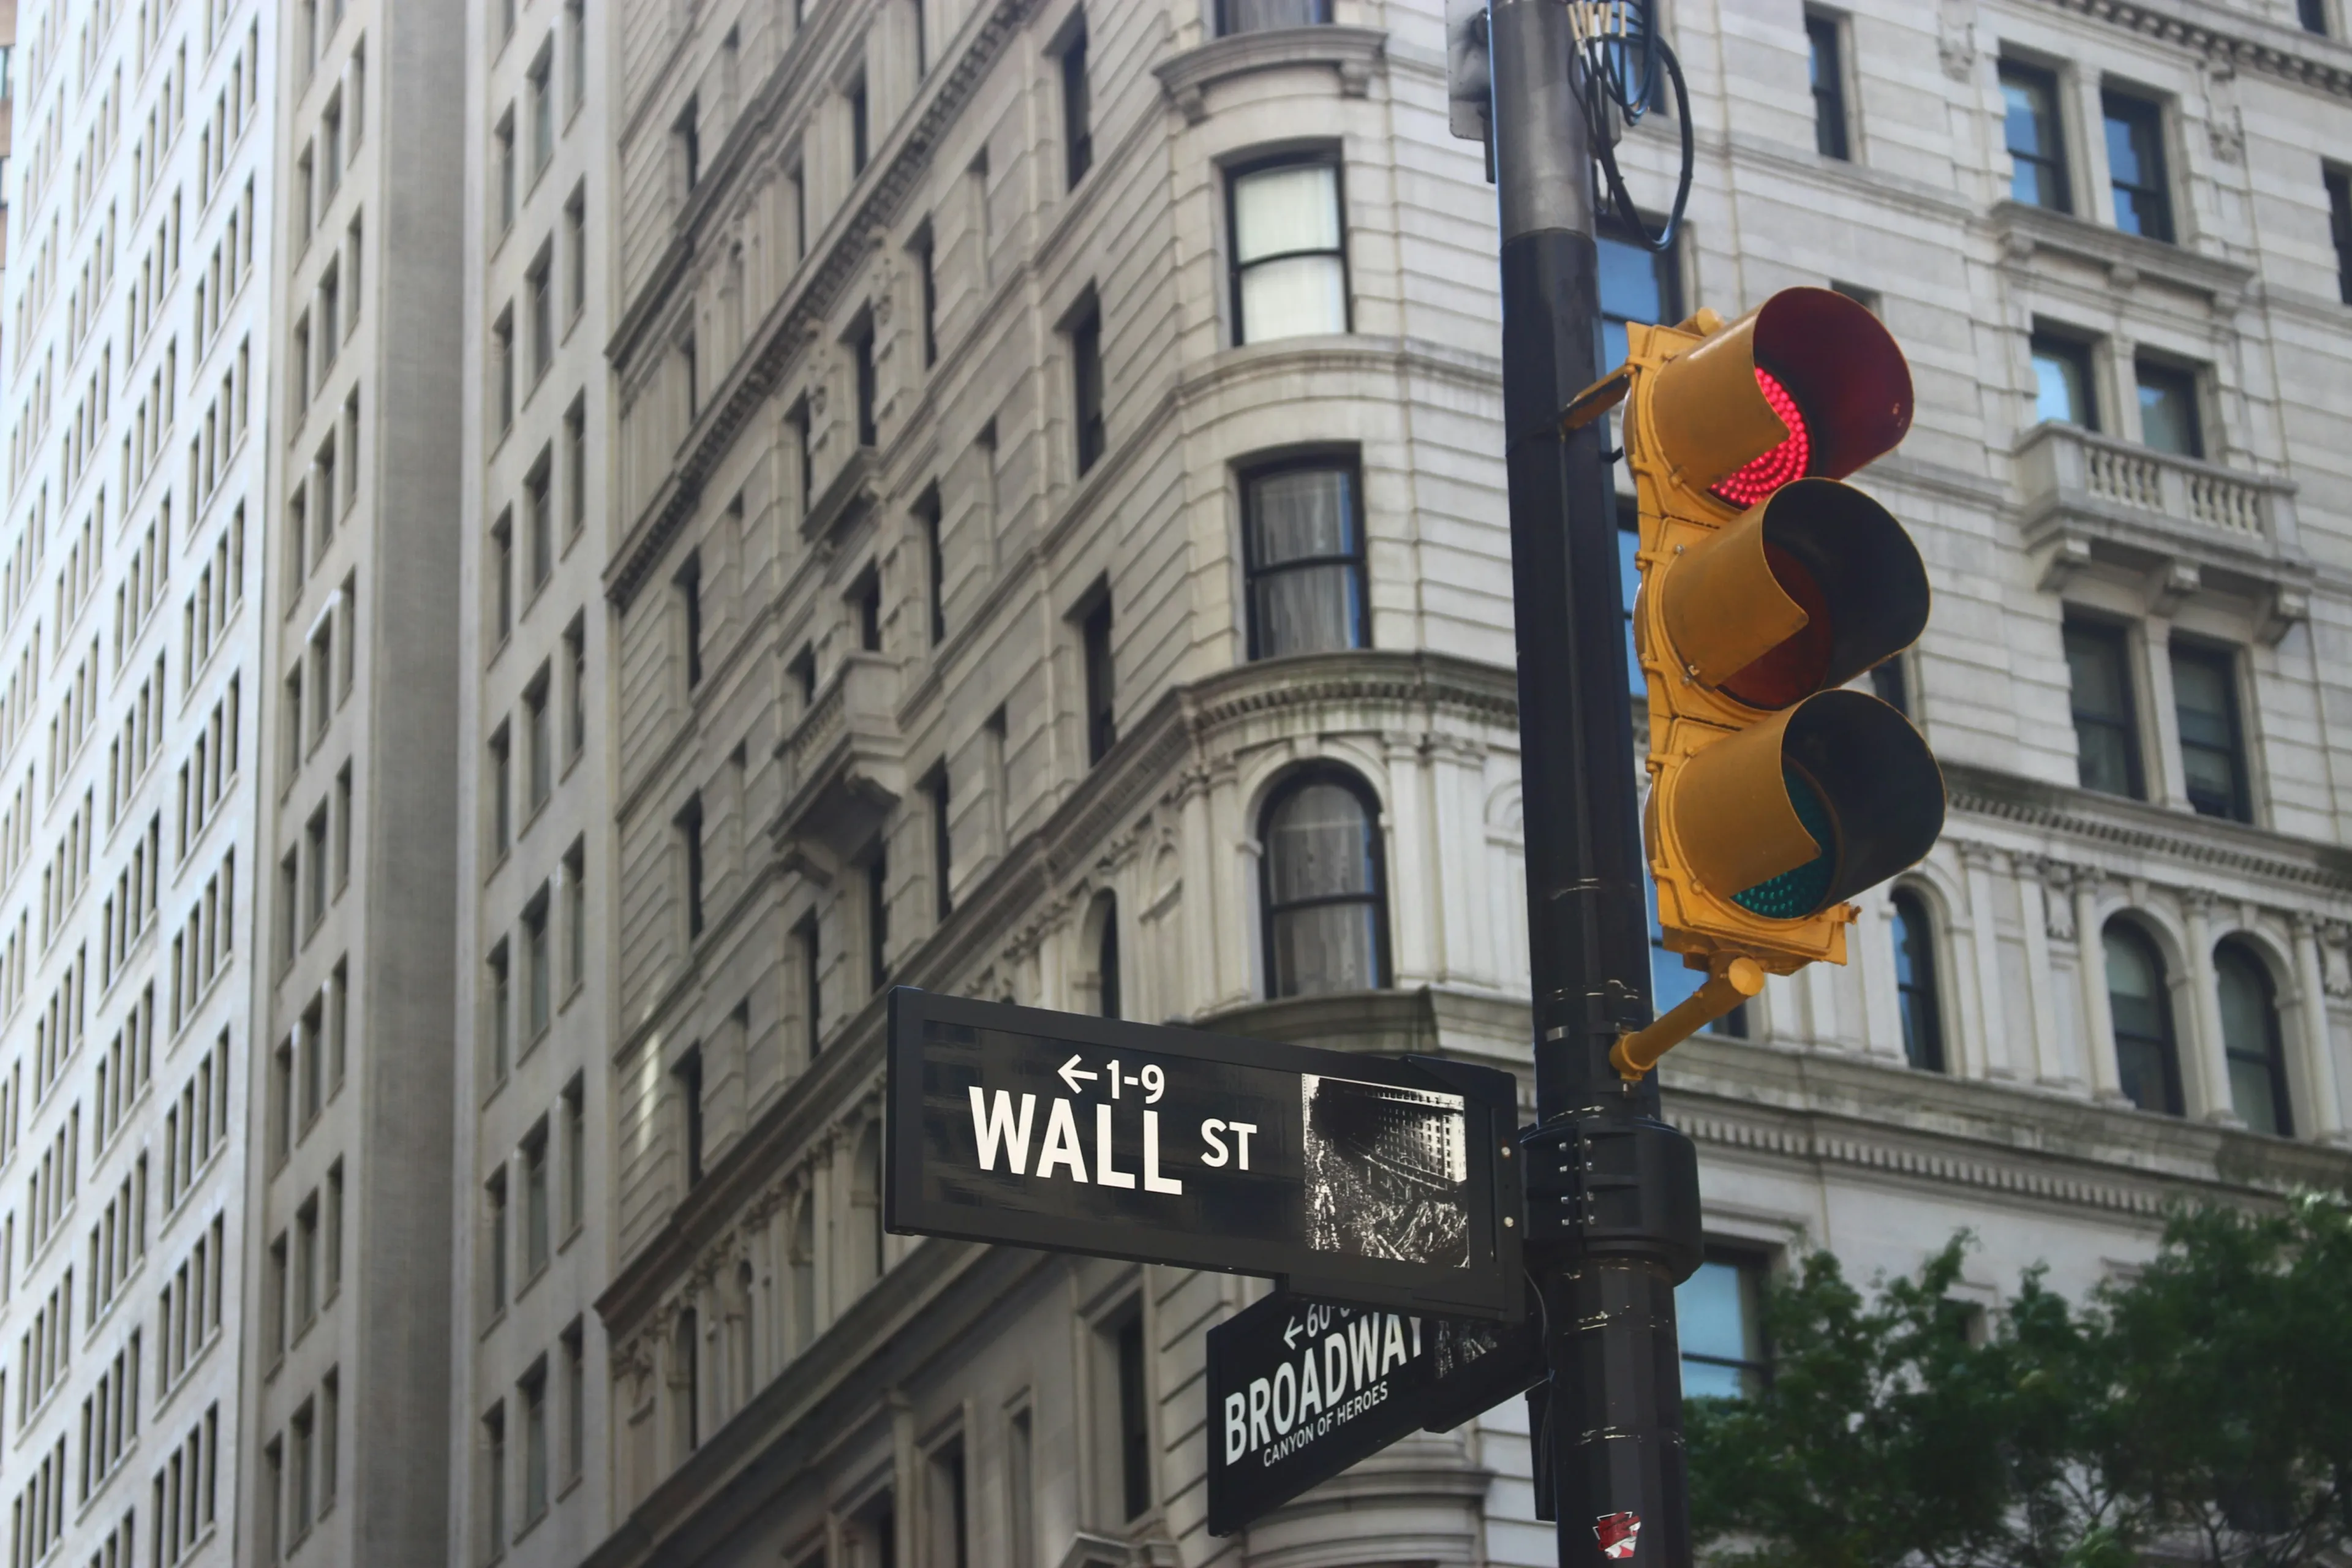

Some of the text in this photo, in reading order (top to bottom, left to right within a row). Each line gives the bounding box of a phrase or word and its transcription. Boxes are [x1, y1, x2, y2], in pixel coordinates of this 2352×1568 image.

[1106, 1059, 1166, 1105] 1-9
[968, 1085, 1257, 1195] WALL ST
[1225, 1312, 1421, 1466] BROADWAY
[1264, 1381, 1389, 1467] CANYON OF HEROES
